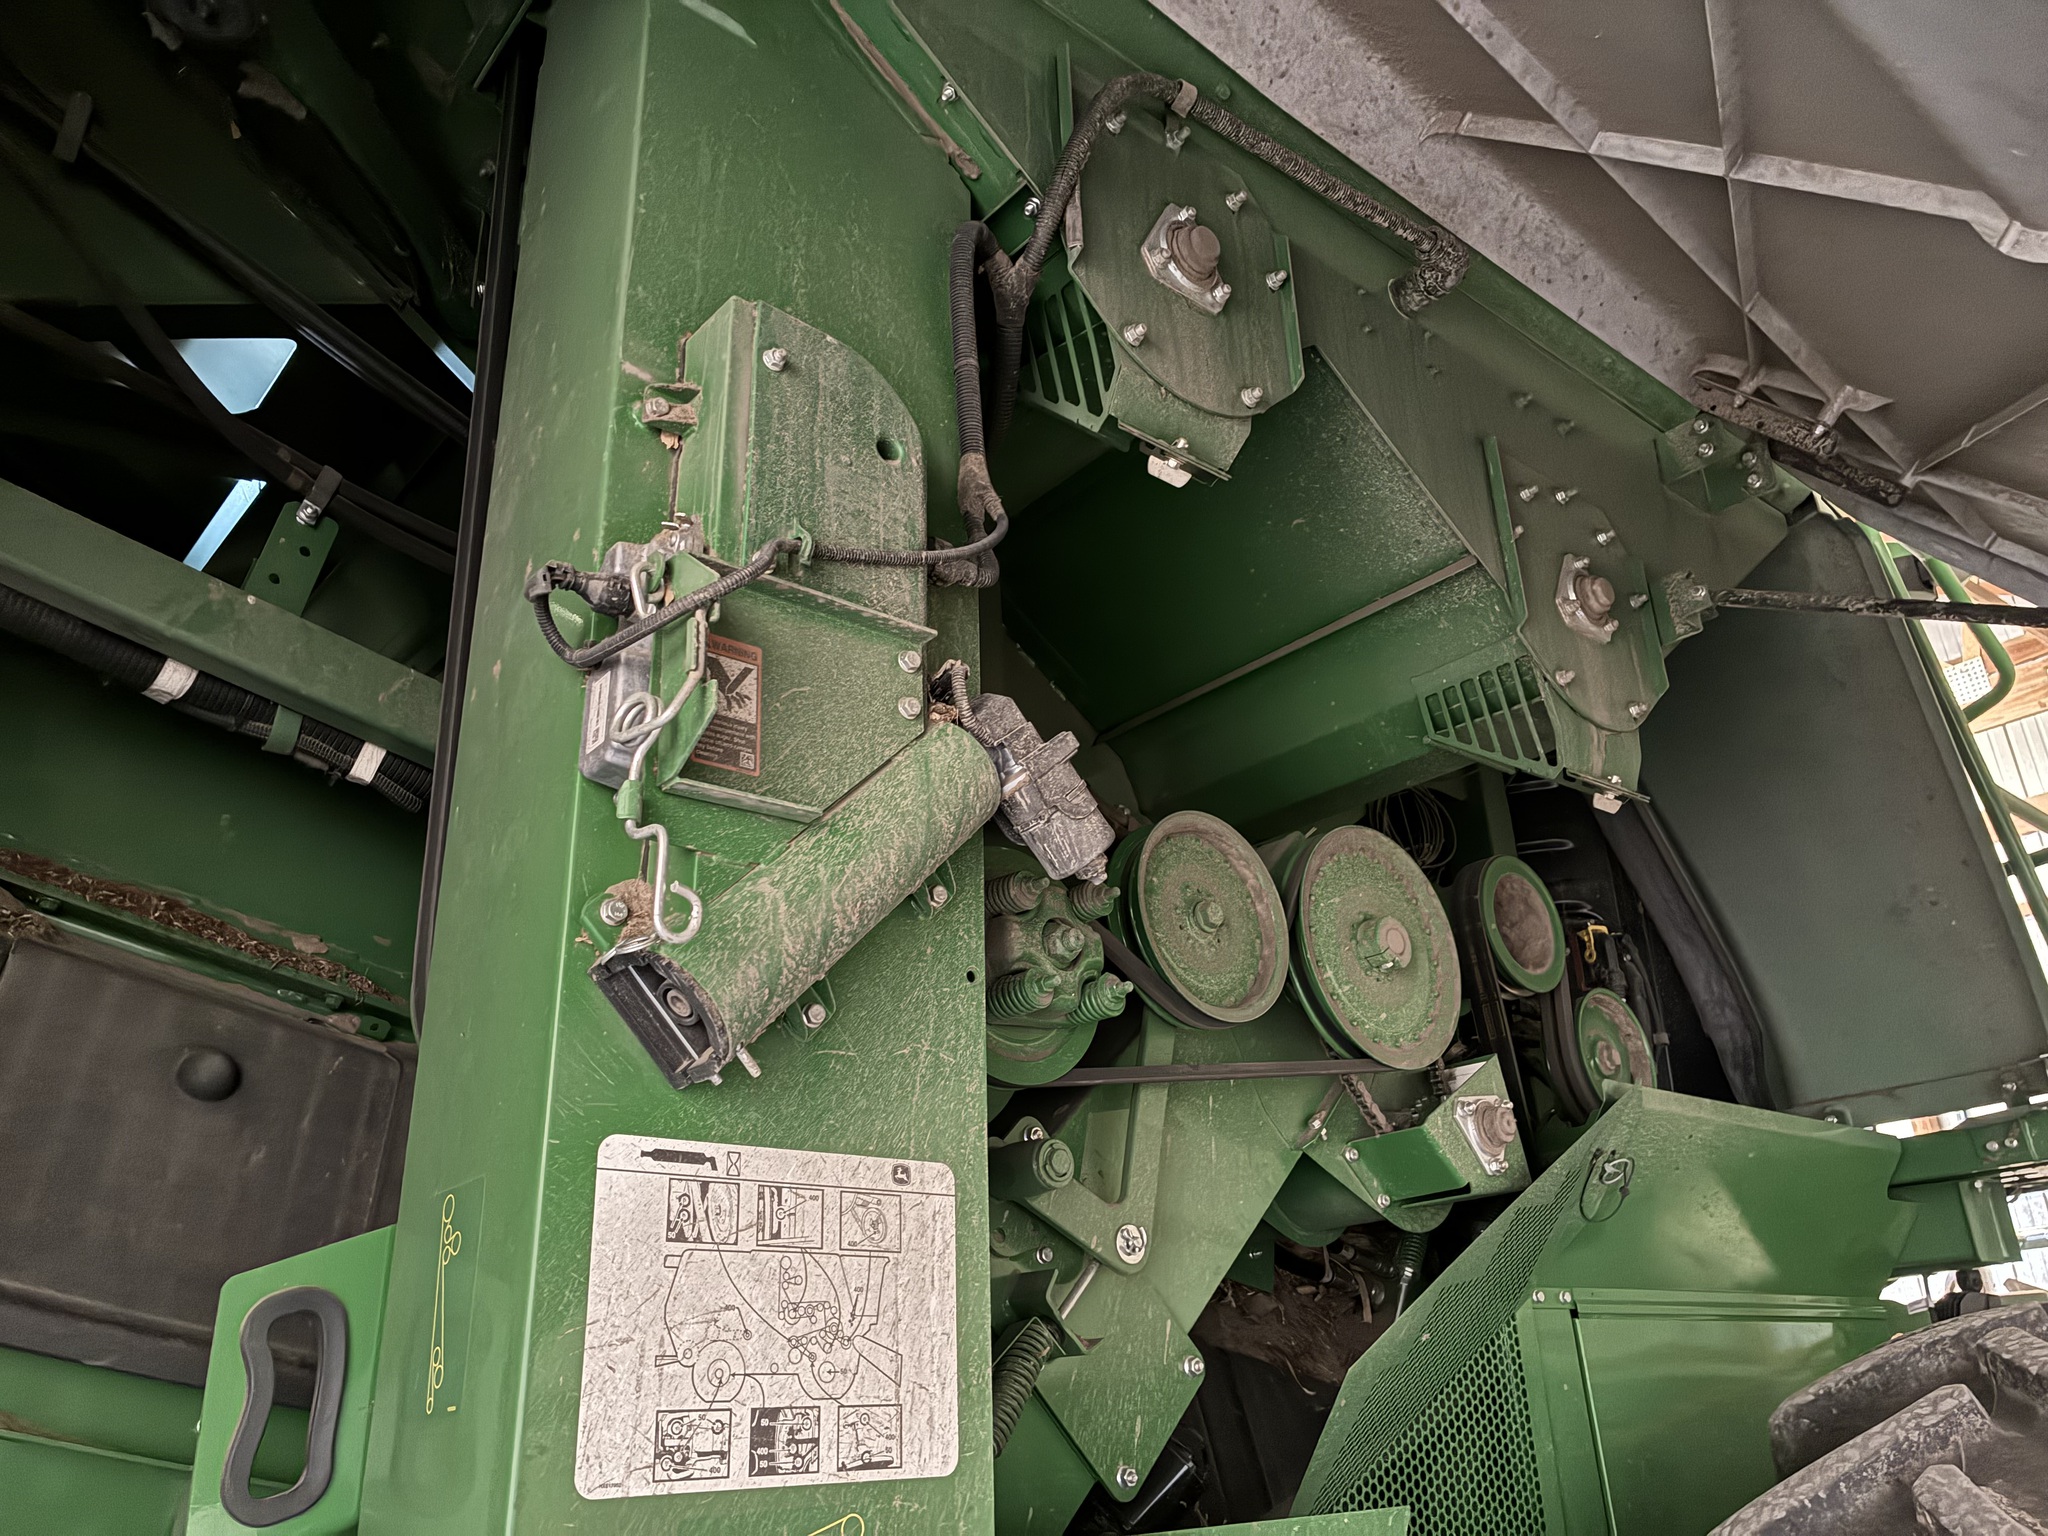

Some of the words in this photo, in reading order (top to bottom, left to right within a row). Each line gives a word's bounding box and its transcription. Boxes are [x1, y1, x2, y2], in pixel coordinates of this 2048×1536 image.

[808, 1194, 820, 1202] 400
[667, 1231, 676, 1239] 50
[853, 1286, 864, 1294] 400
[756, 1447, 769, 1455] 400
[759, 1460, 768, 1468] 50
[708, 1466, 721, 1475] 400
